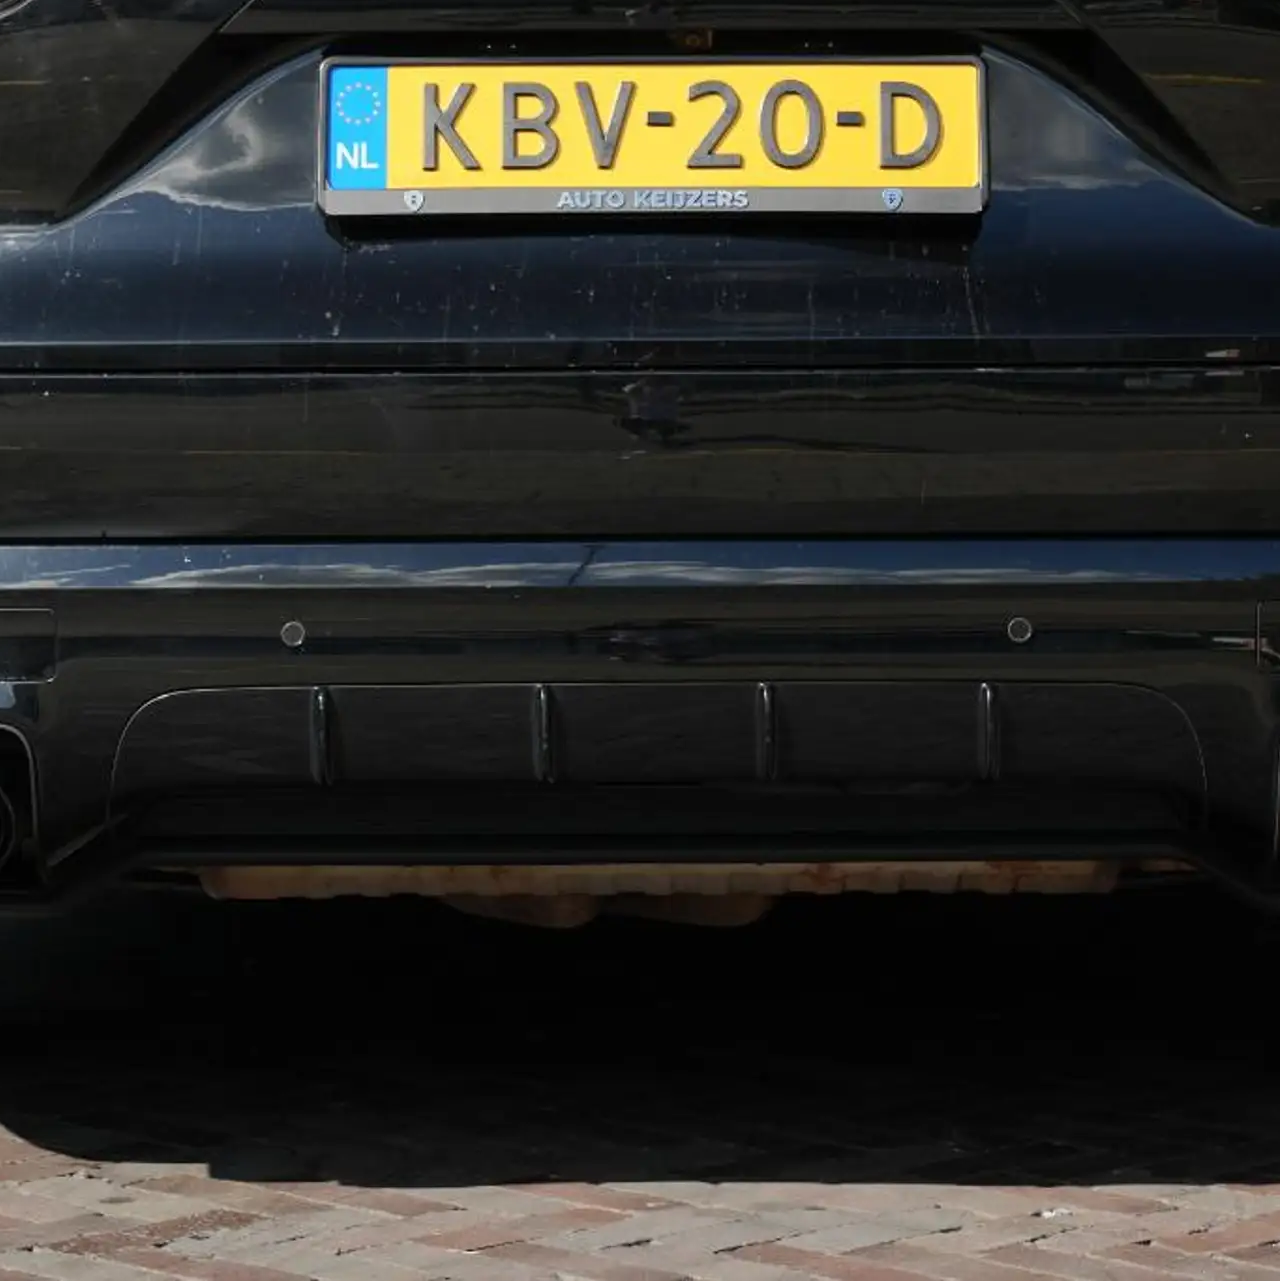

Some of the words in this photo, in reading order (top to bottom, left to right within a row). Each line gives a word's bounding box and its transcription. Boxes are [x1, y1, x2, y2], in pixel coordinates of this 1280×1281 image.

[422, 80, 943, 170] KBV-20-D
[337, 143, 378, 169] NL
[557, 190, 625, 208] AUTO
[634, 190, 748, 208] KEIJZERS
